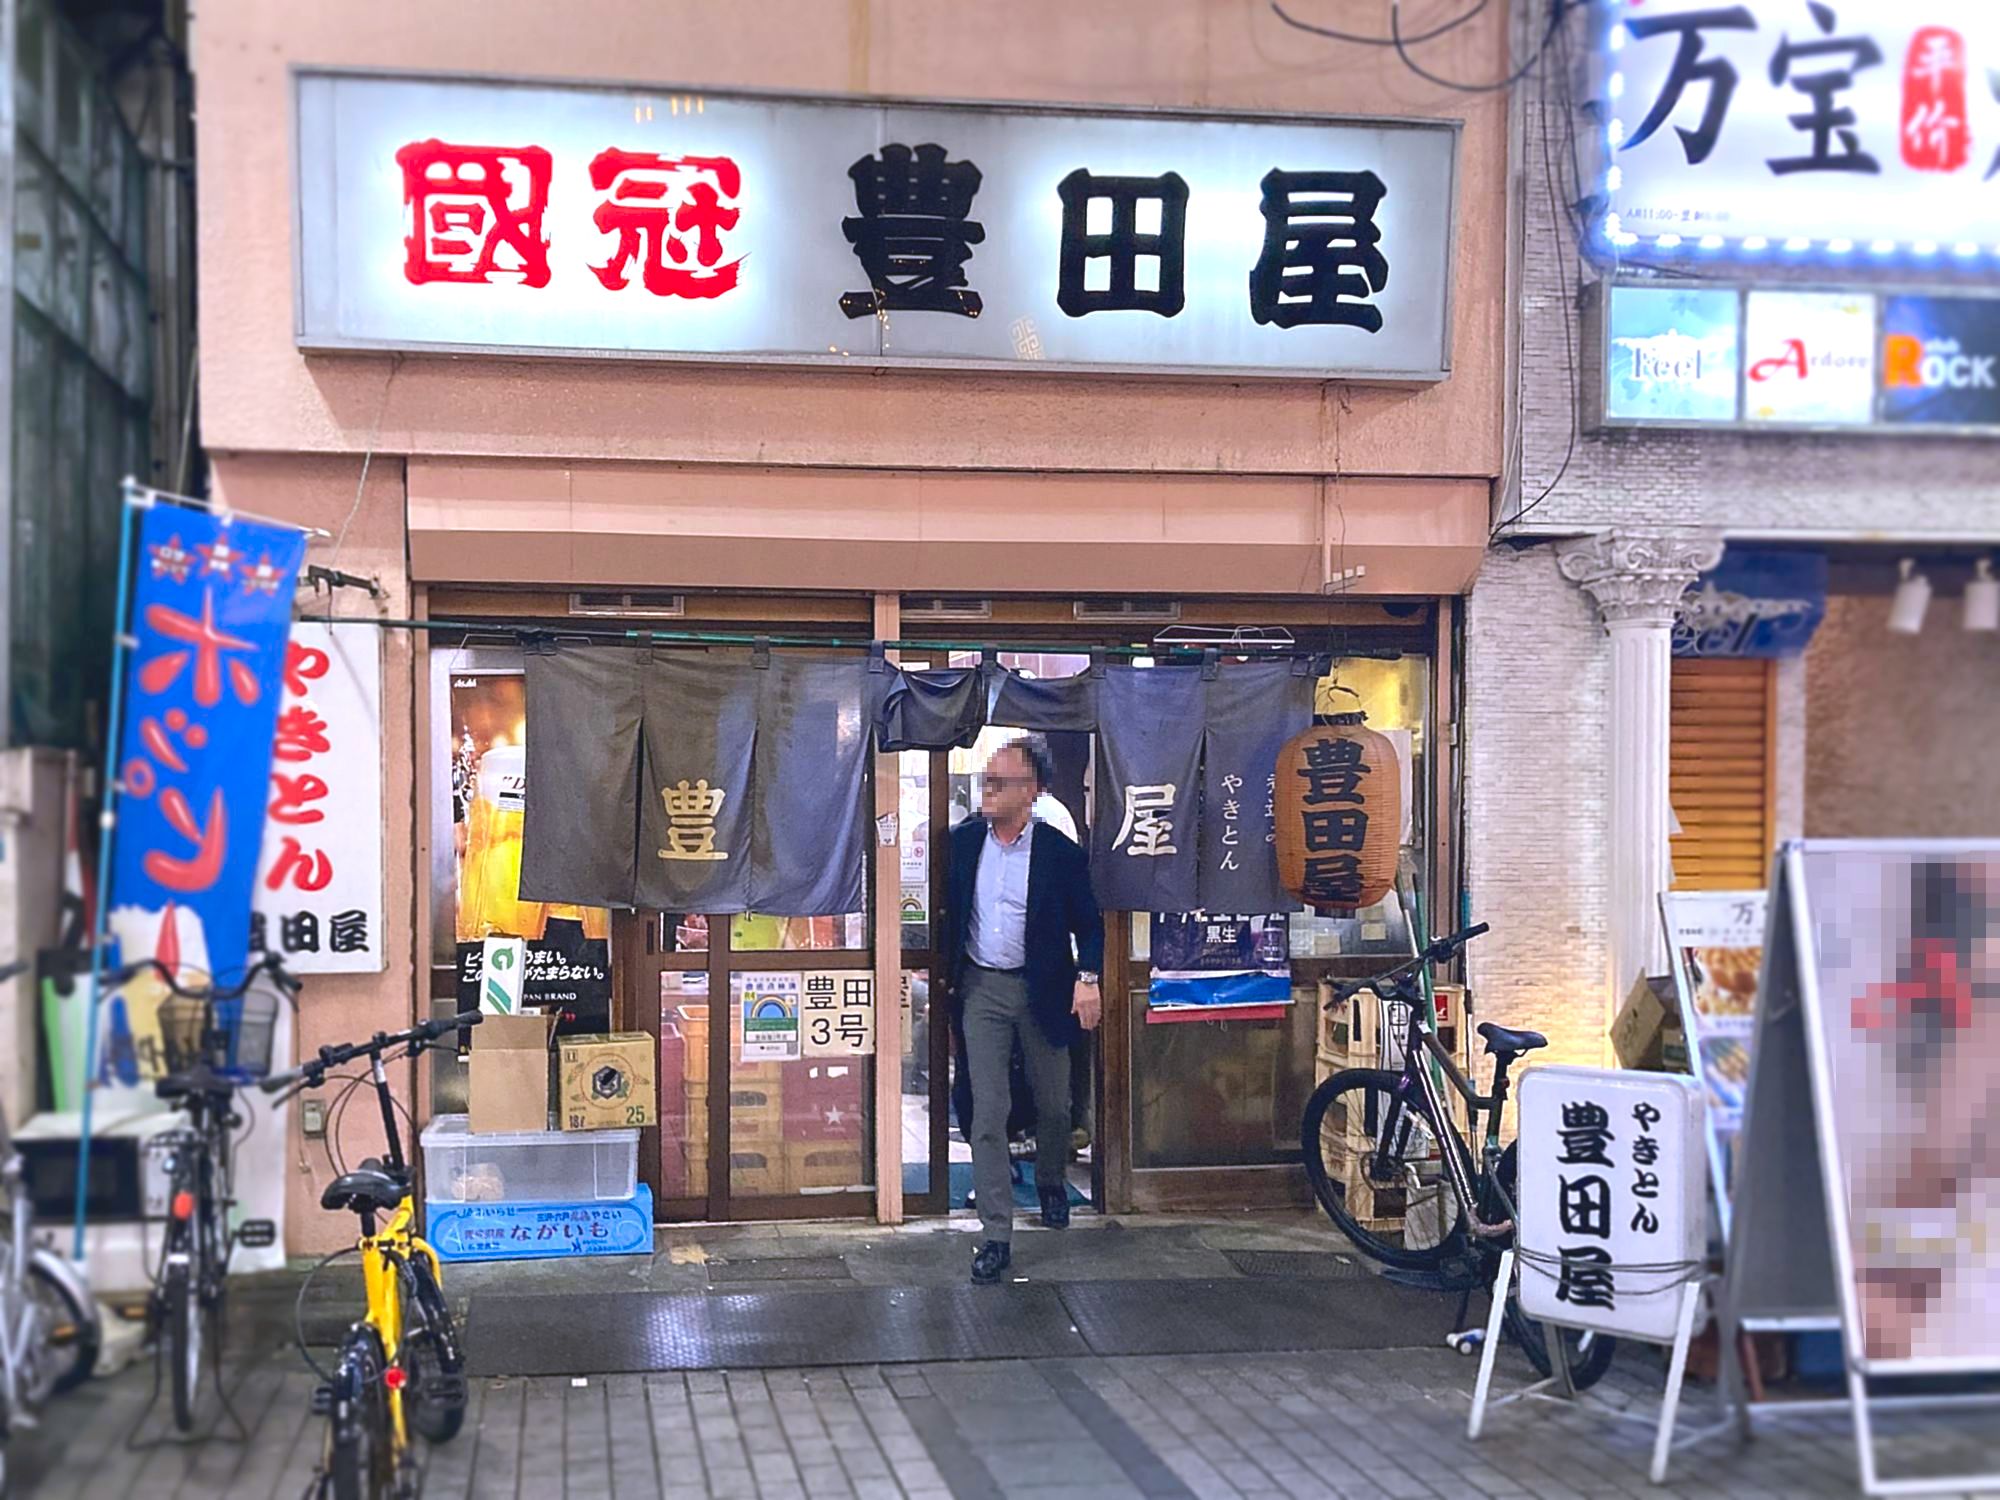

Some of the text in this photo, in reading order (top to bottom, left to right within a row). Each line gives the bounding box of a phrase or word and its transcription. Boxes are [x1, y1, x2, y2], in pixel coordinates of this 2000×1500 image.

[1618, 0, 1883, 176] 万宝
[395, 138, 1389, 334] 國冠 豊田屋
[1883, 333, 1997, 390] ROCK
[265, 640, 333, 892] やきとん
[657, 779, 729, 861] 豊
[1111, 783, 1178, 857] 屋
[1220, 774, 1243, 870] やきとん
[1296, 737, 1372, 904] 豊田屋
[1206, 925, 1237, 943] 黒生
[545, 992, 577, 1000] BRAND
[626, 1105, 645, 1124] 25
[1556, 1100, 1616, 1311] 豊田屋
[1630, 1101, 1661, 1234] やきとん
[511, 1217, 608, 1240] ながいも
